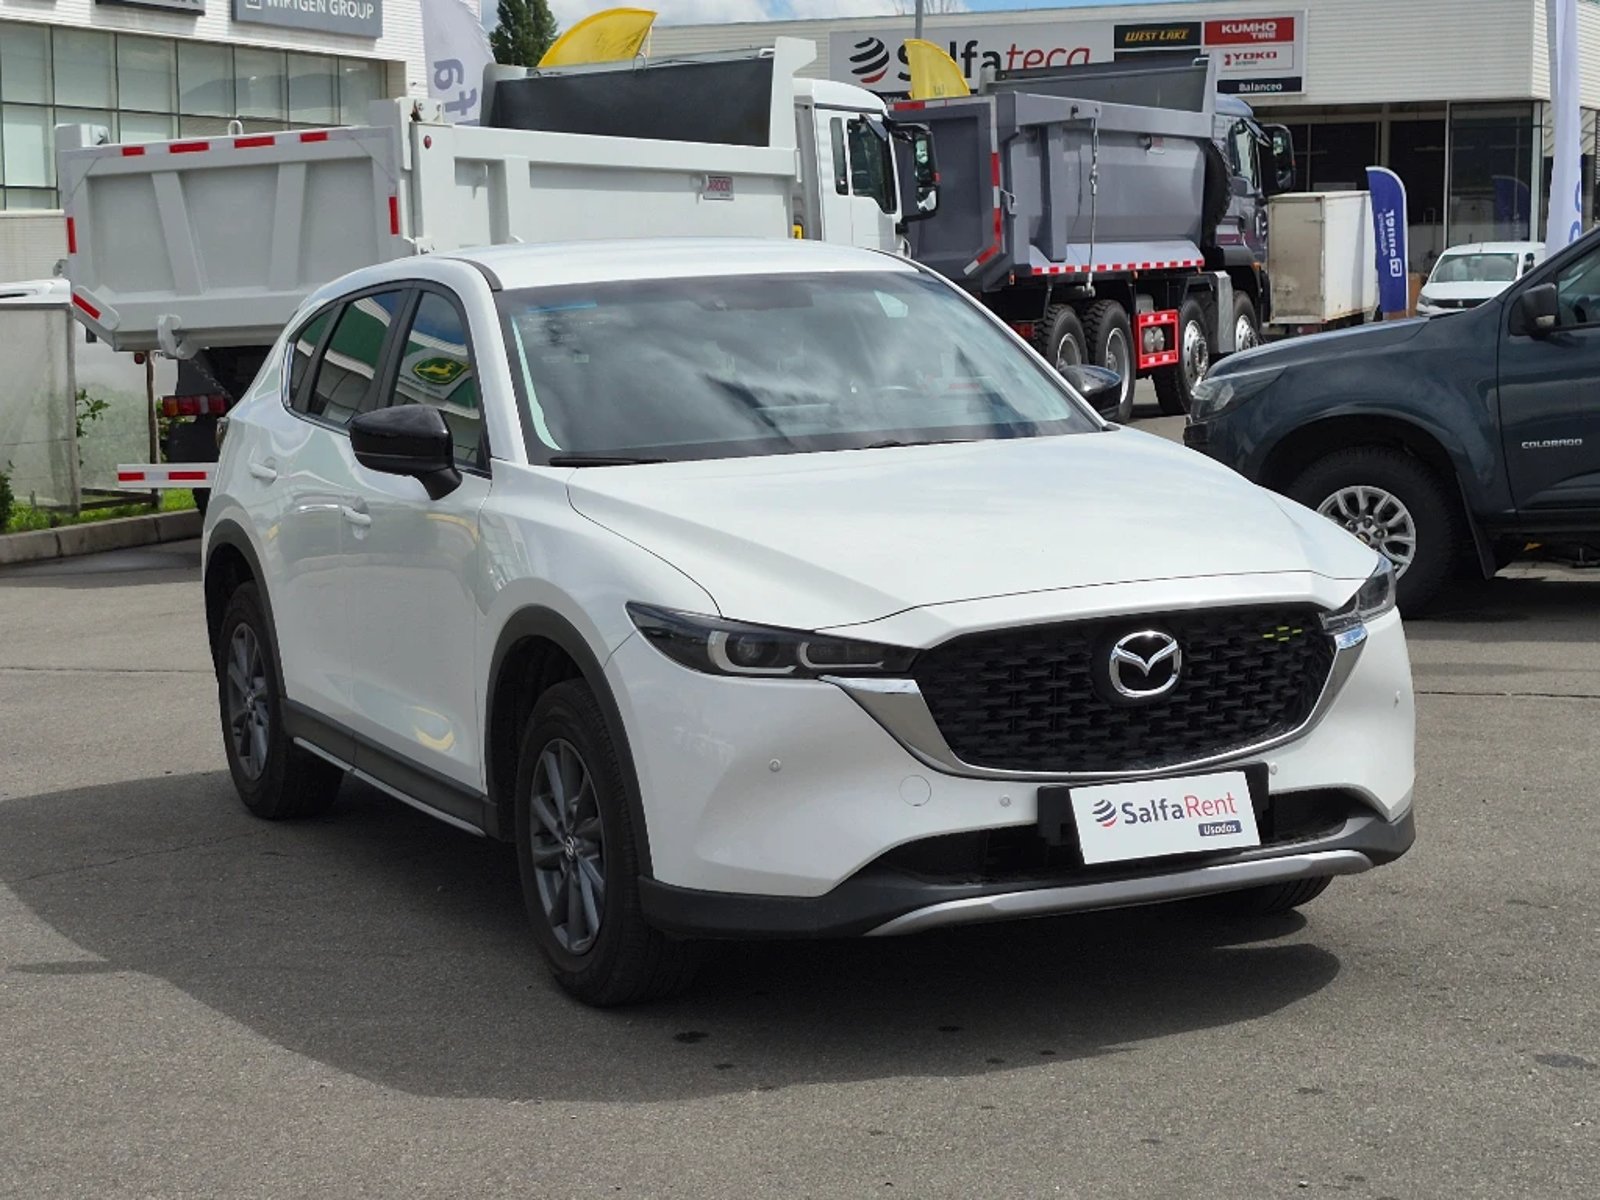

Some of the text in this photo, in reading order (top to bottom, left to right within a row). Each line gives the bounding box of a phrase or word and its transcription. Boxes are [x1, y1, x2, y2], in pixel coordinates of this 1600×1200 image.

[329, 0, 374, 19] GROUP
[1221, 22, 1277, 33] KUMHO
[1125, 30, 1189, 42] WEST LAKE
[1239, 82, 1283, 93] Balanceo
[1521, 438, 1583, 449] COLORADO
[1121, 791, 1237, 825] SalfaRent
[1203, 823, 1237, 836] Usados
